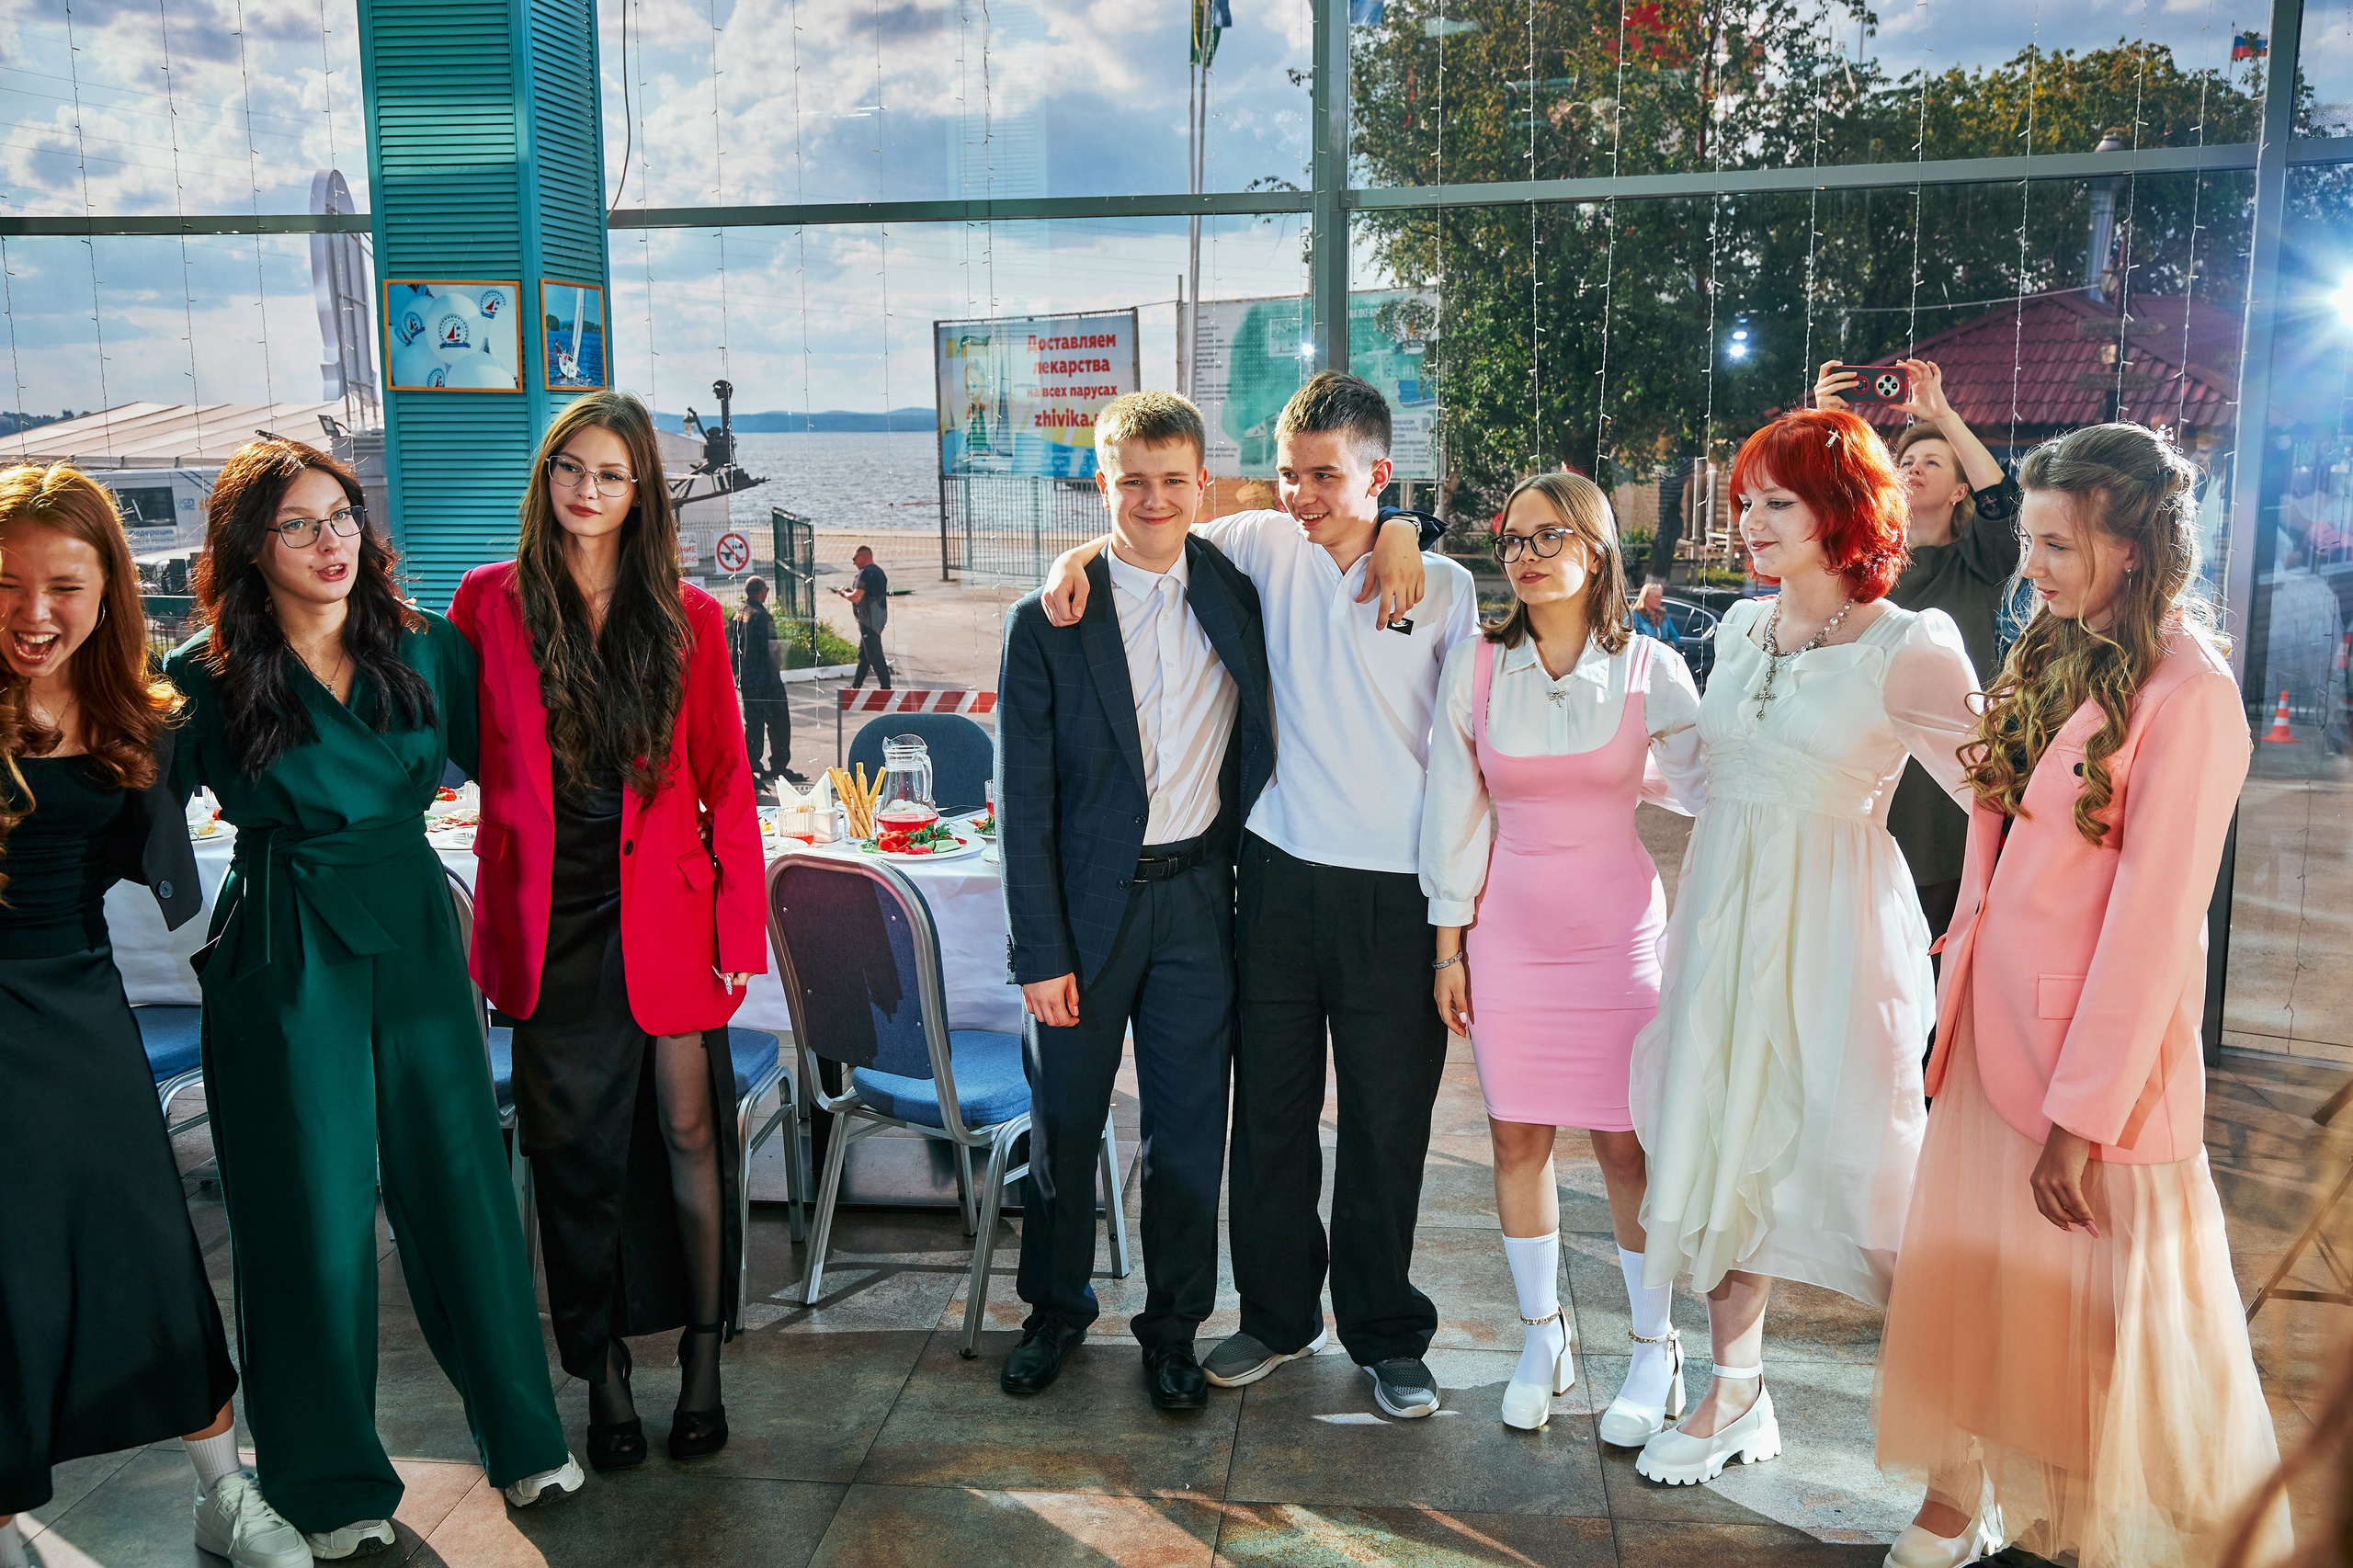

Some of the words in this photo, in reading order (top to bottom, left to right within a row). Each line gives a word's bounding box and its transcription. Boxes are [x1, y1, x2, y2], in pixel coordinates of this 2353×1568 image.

[1027, 334, 1116, 354] Доставляем
[1033, 358, 1110, 378] лекарства
[1027, 388, 1040, 398] на
[1041, 387, 1067, 397] всех
[1069, 385, 1118, 400] парусах
